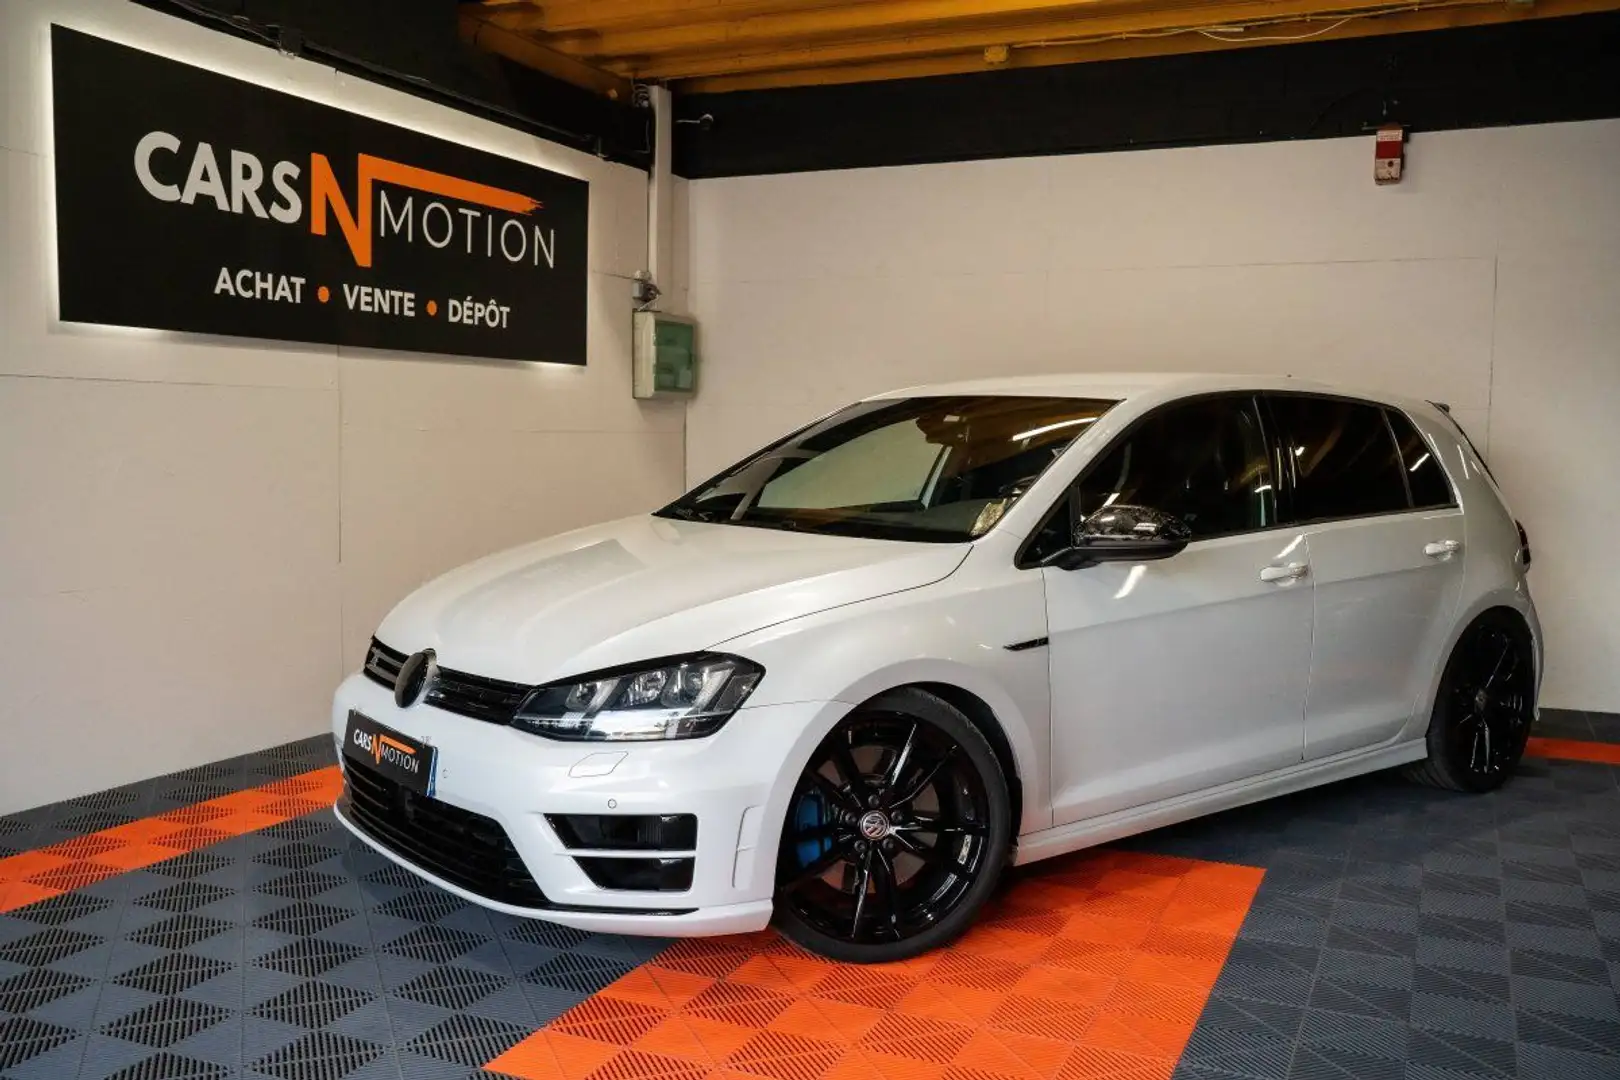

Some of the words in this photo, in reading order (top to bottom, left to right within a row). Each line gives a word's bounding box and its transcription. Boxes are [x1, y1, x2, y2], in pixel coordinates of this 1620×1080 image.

[134, 131, 302, 224] CARS
[380, 190, 554, 269] MOTION
[214, 267, 306, 304] ACHAT
[343, 284, 416, 317] VENTE
[448, 296, 511, 329] DÉPÔT
